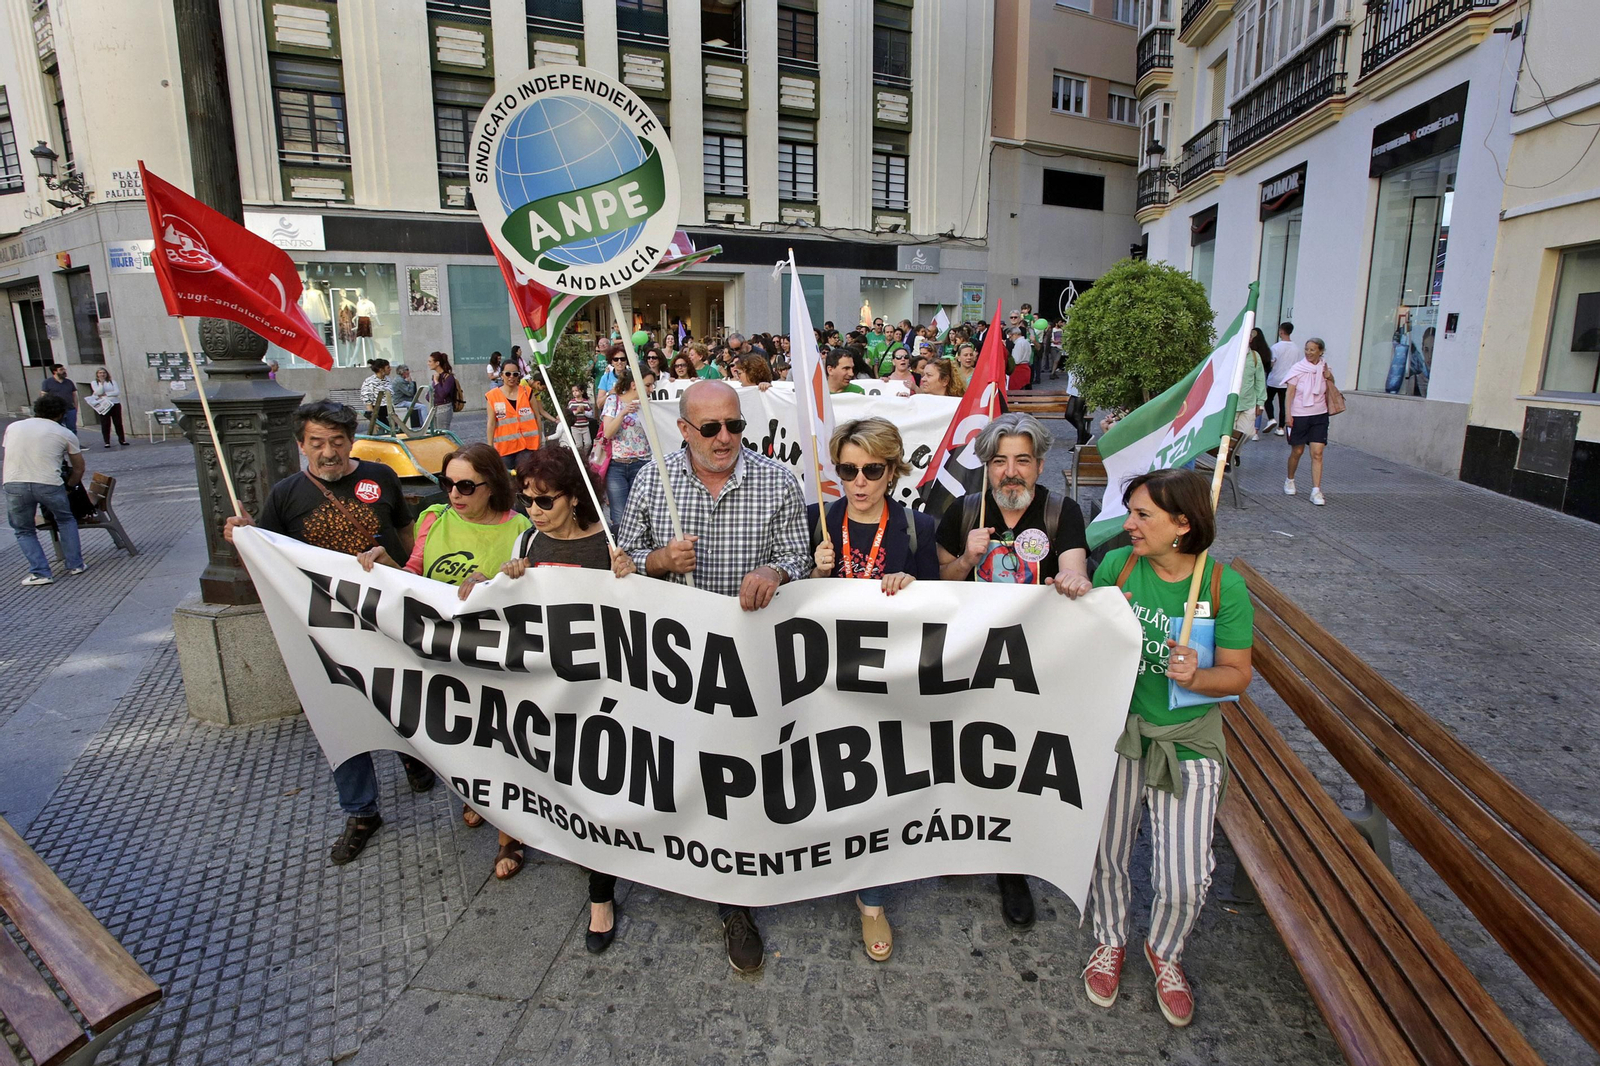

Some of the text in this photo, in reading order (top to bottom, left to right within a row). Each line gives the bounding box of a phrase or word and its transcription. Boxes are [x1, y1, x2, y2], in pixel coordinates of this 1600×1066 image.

[476, 74, 656, 184] SINDICATO INDEPENDIENTE
[105, 189, 145, 198] PALILL
[112, 171, 140, 180] PLAZ
[120, 180, 141, 189] DEL
[1262, 172, 1299, 202] PRIMOR
[528, 181, 649, 251] ANPE
[110, 257, 134, 268] MUJER
[556, 244, 660, 291] ANDALUCÍA
[360, 482, 379, 494] UGT
[403, 597, 759, 718] DEFENSA
[774, 618, 889, 707] DE
[919, 622, 1040, 696] LA
[699, 720, 1083, 825] PÚBLICA
[451, 776, 1012, 877] DE PERSONAL DOCENTE DE CÁDIZ
